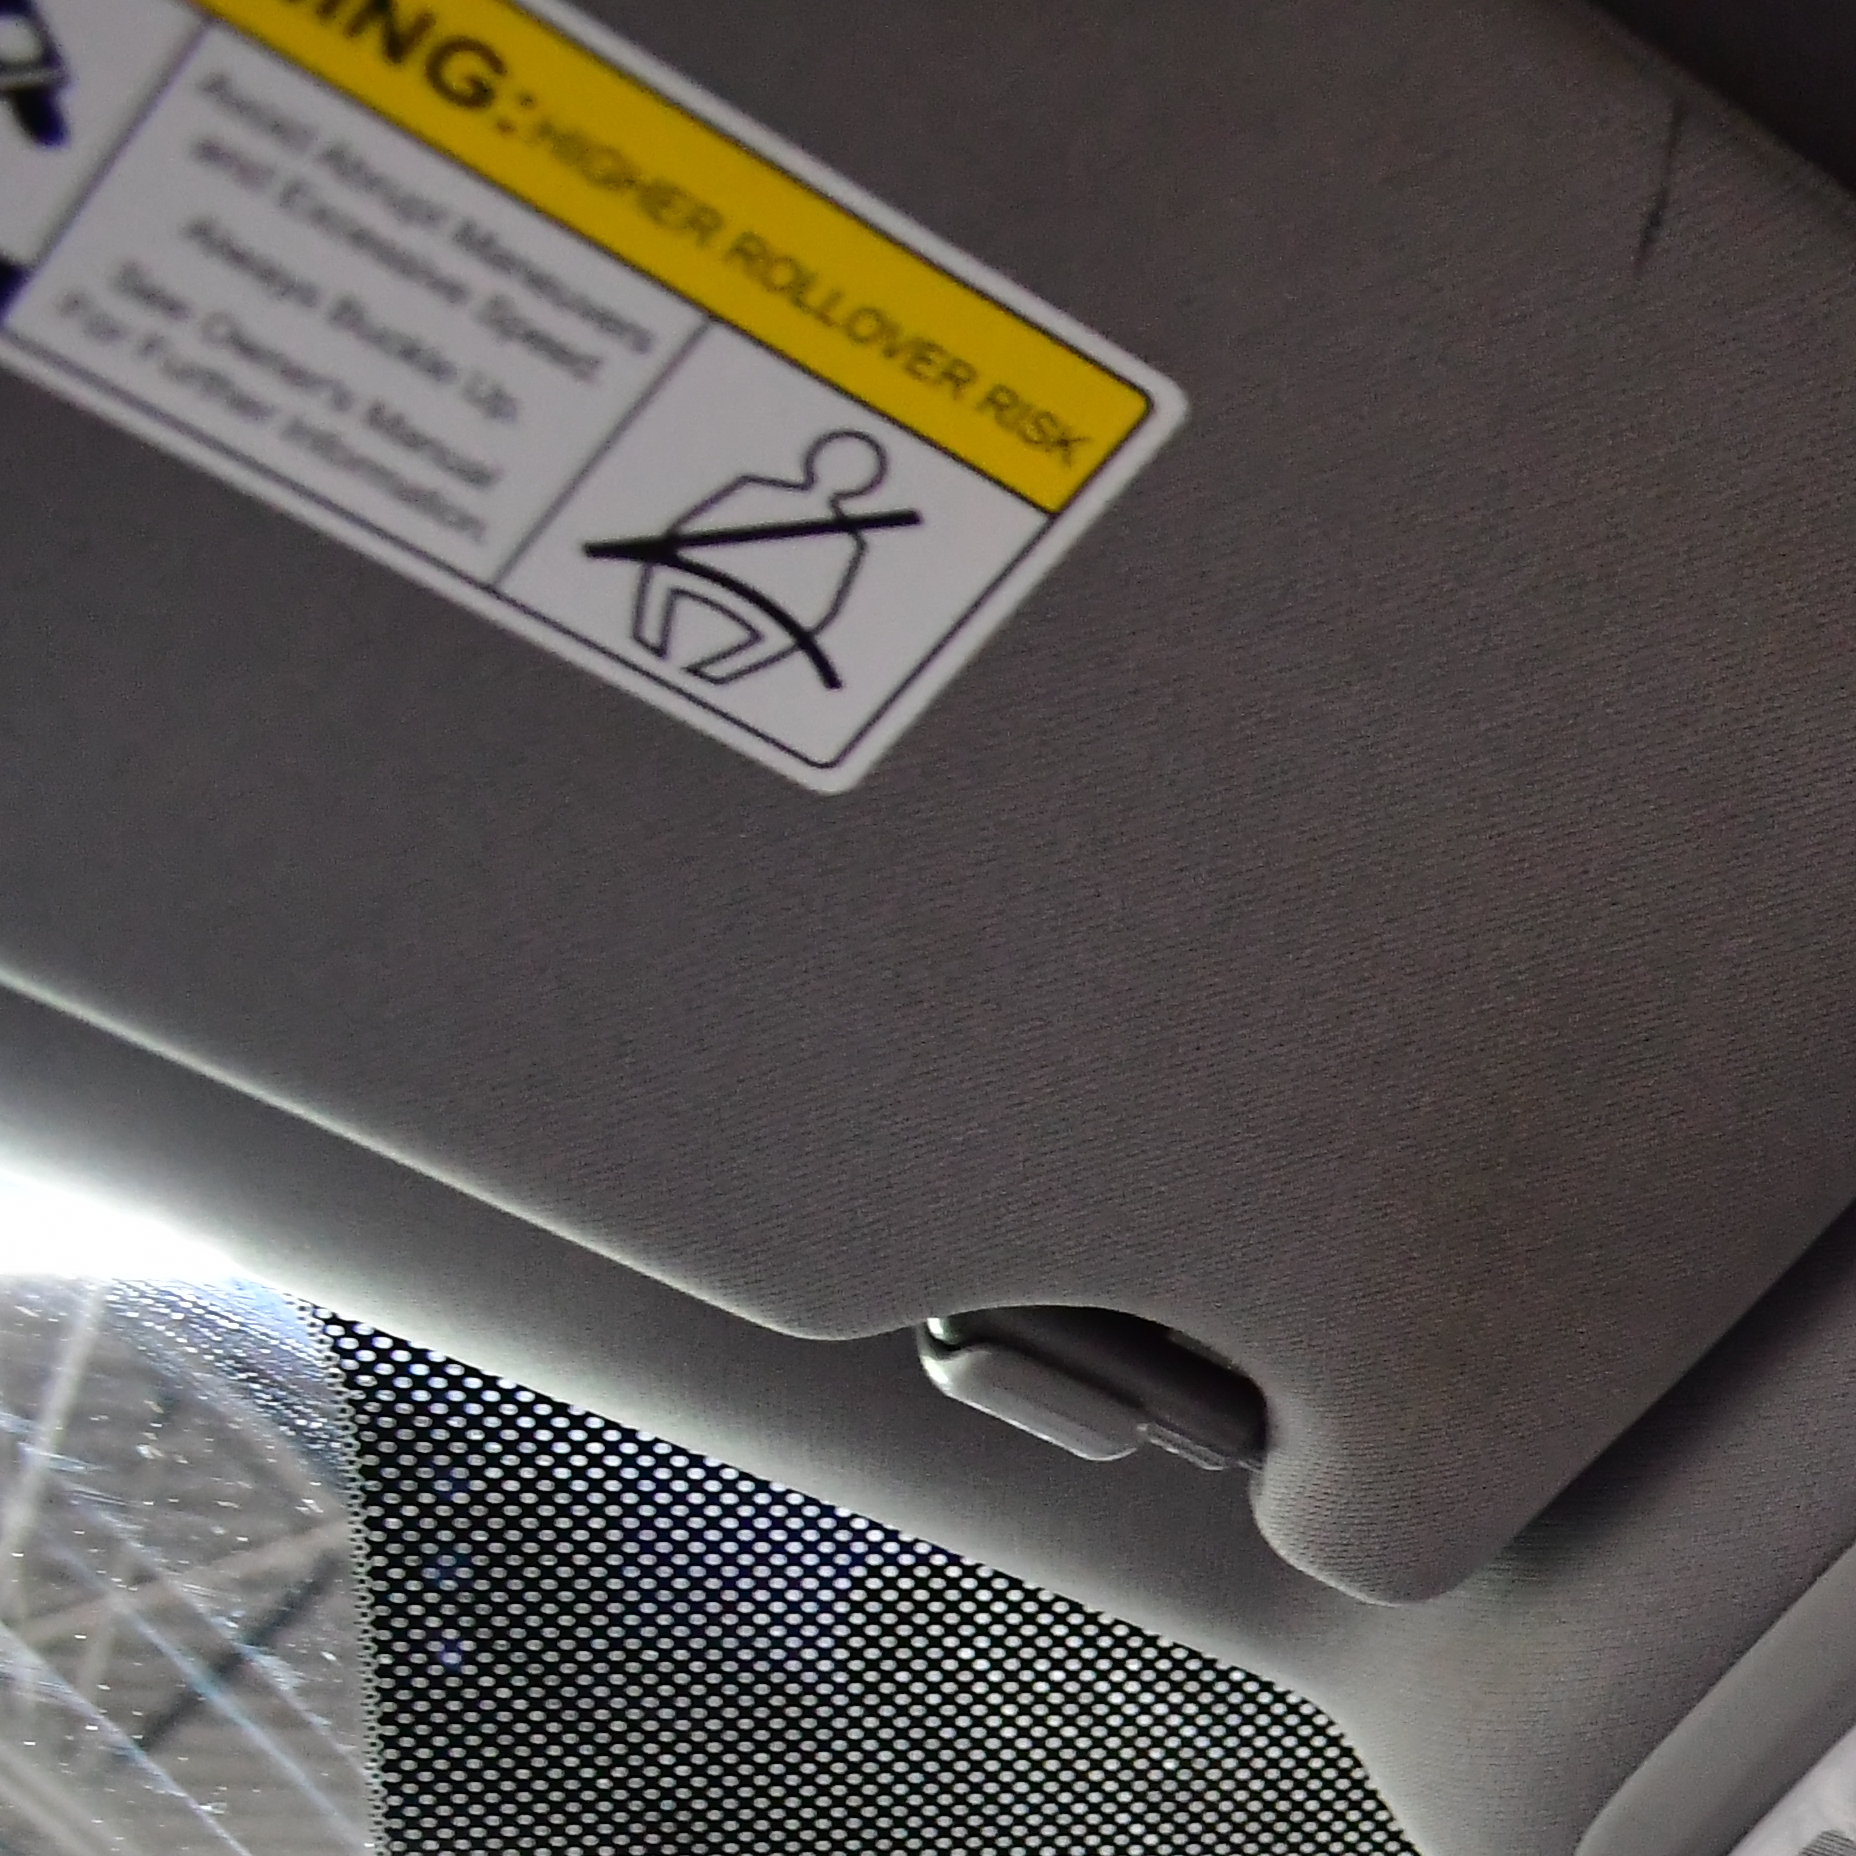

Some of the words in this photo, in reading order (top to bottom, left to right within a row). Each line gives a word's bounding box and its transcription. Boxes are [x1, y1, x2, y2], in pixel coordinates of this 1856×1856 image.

[531, 120, 723, 248] HIGHER
[724, 231, 978, 401] ROLLOVER
[974, 386, 1091, 468] RISK
